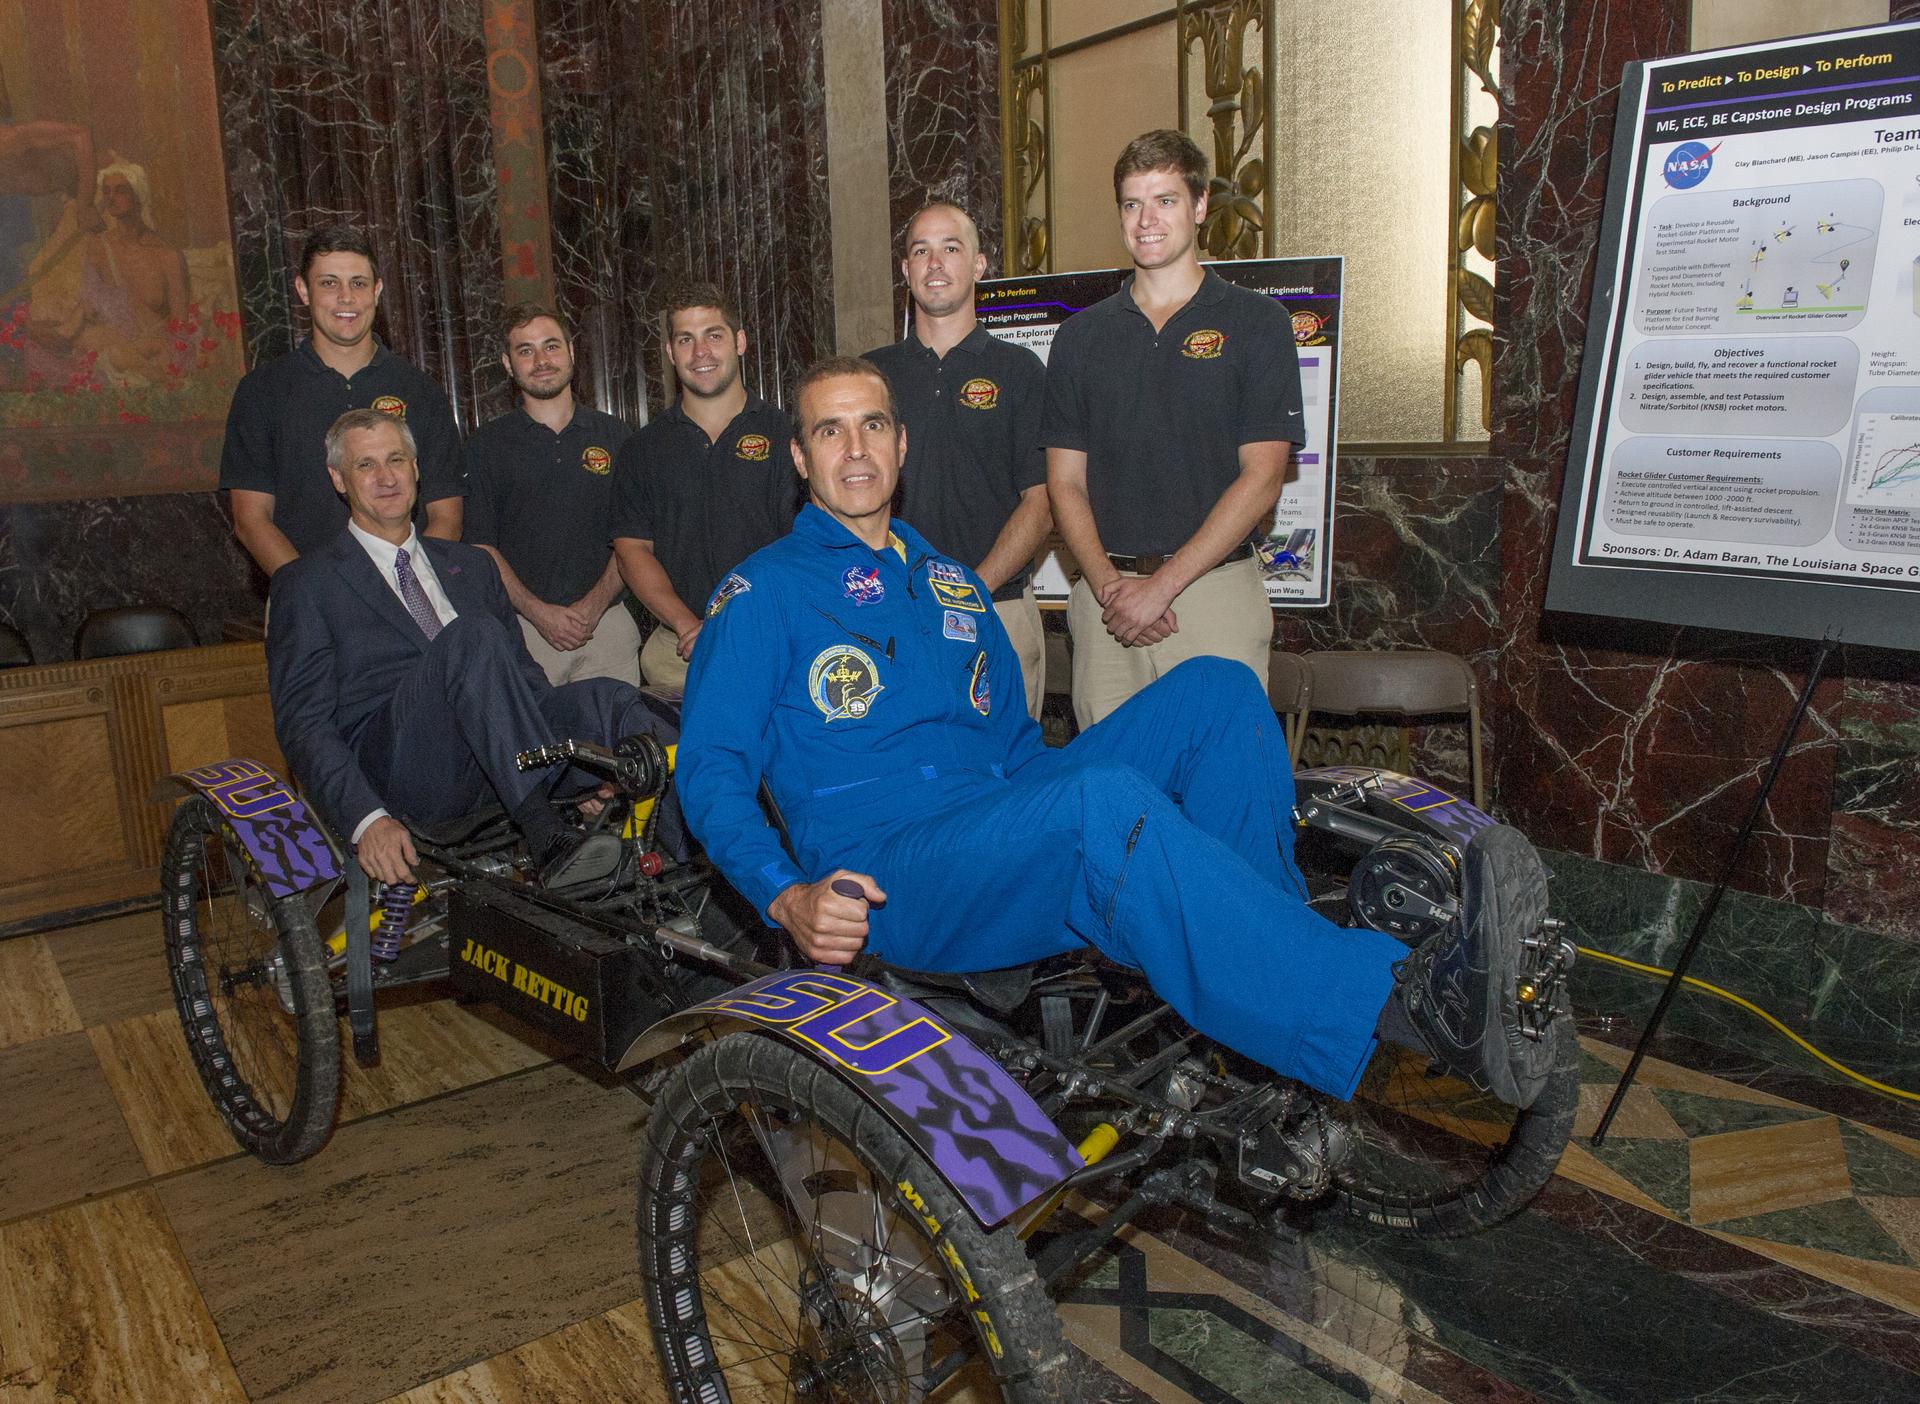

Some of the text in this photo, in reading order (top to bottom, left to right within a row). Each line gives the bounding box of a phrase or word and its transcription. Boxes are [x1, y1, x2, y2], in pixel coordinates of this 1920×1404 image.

[1662, 52, 1892, 93] To Predict To Design To Perform
[1656, 92, 1912, 133] ME, ECE, BE Capstone Design Programs
[1752, 157, 1786, 166] Blanchard
[1807, 153, 1829, 161] Jason
[1668, 159, 1709, 172] NASA
[1733, 195, 1791, 207] Background
[1706, 218, 1734, 226] Reusable
[1656, 239, 1696, 247] Experimental
[997, 290, 1006, 298] To
[1007, 288, 1036, 297] Perform
[1269, 286, 1314, 296] Engineering
[988, 314, 1012, 323] Design
[1013, 312, 1048, 321] Programs
[1714, 349, 1764, 358] Objectives
[1646, 362, 1673, 370] Design,
[1674, 361, 1696, 369] build,
[1767, 360, 1808, 368] functional
[1810, 360, 1837, 368] rocket
[1644, 372, 1665, 381] glider
[1754, 372, 1789, 380] required
[1643, 383, 1695, 391] specifications.
[1642, 393, 1668, 401] Design,
[1670, 393, 1706, 401] assemble,
[1640, 403, 1699, 411] Nitrate/Sorbitol
[1666, 448, 1782, 460] Customer Requirements
[1668, 472, 1704, 481] Customer
[1648, 482, 1681, 490] controlled
[1683, 503, 1720, 511] controlled,
[1722, 505, 1762, 513] lift-assisted
[1648, 510, 1682, 519] reusability
[1684, 512, 1710, 520] (Launch
[1720, 514, 1752, 523] Recovery
[1602, 543, 1660, 558] Sponsors:
[1664, 547, 1680, 558] Dr.
[1683, 549, 1718, 561] Adam
[1722, 552, 1761, 566] Baran,
[1766, 555, 1789, 566] The
[1793, 557, 1856, 572] Louisiana
[1861, 562, 1903, 575] Space
[846, 578, 883, 591] NASA
[1283, 587, 1304, 596] Wang
[850, 703, 865, 711] 39
[461, 938, 588, 1024] JACK RETTIG
